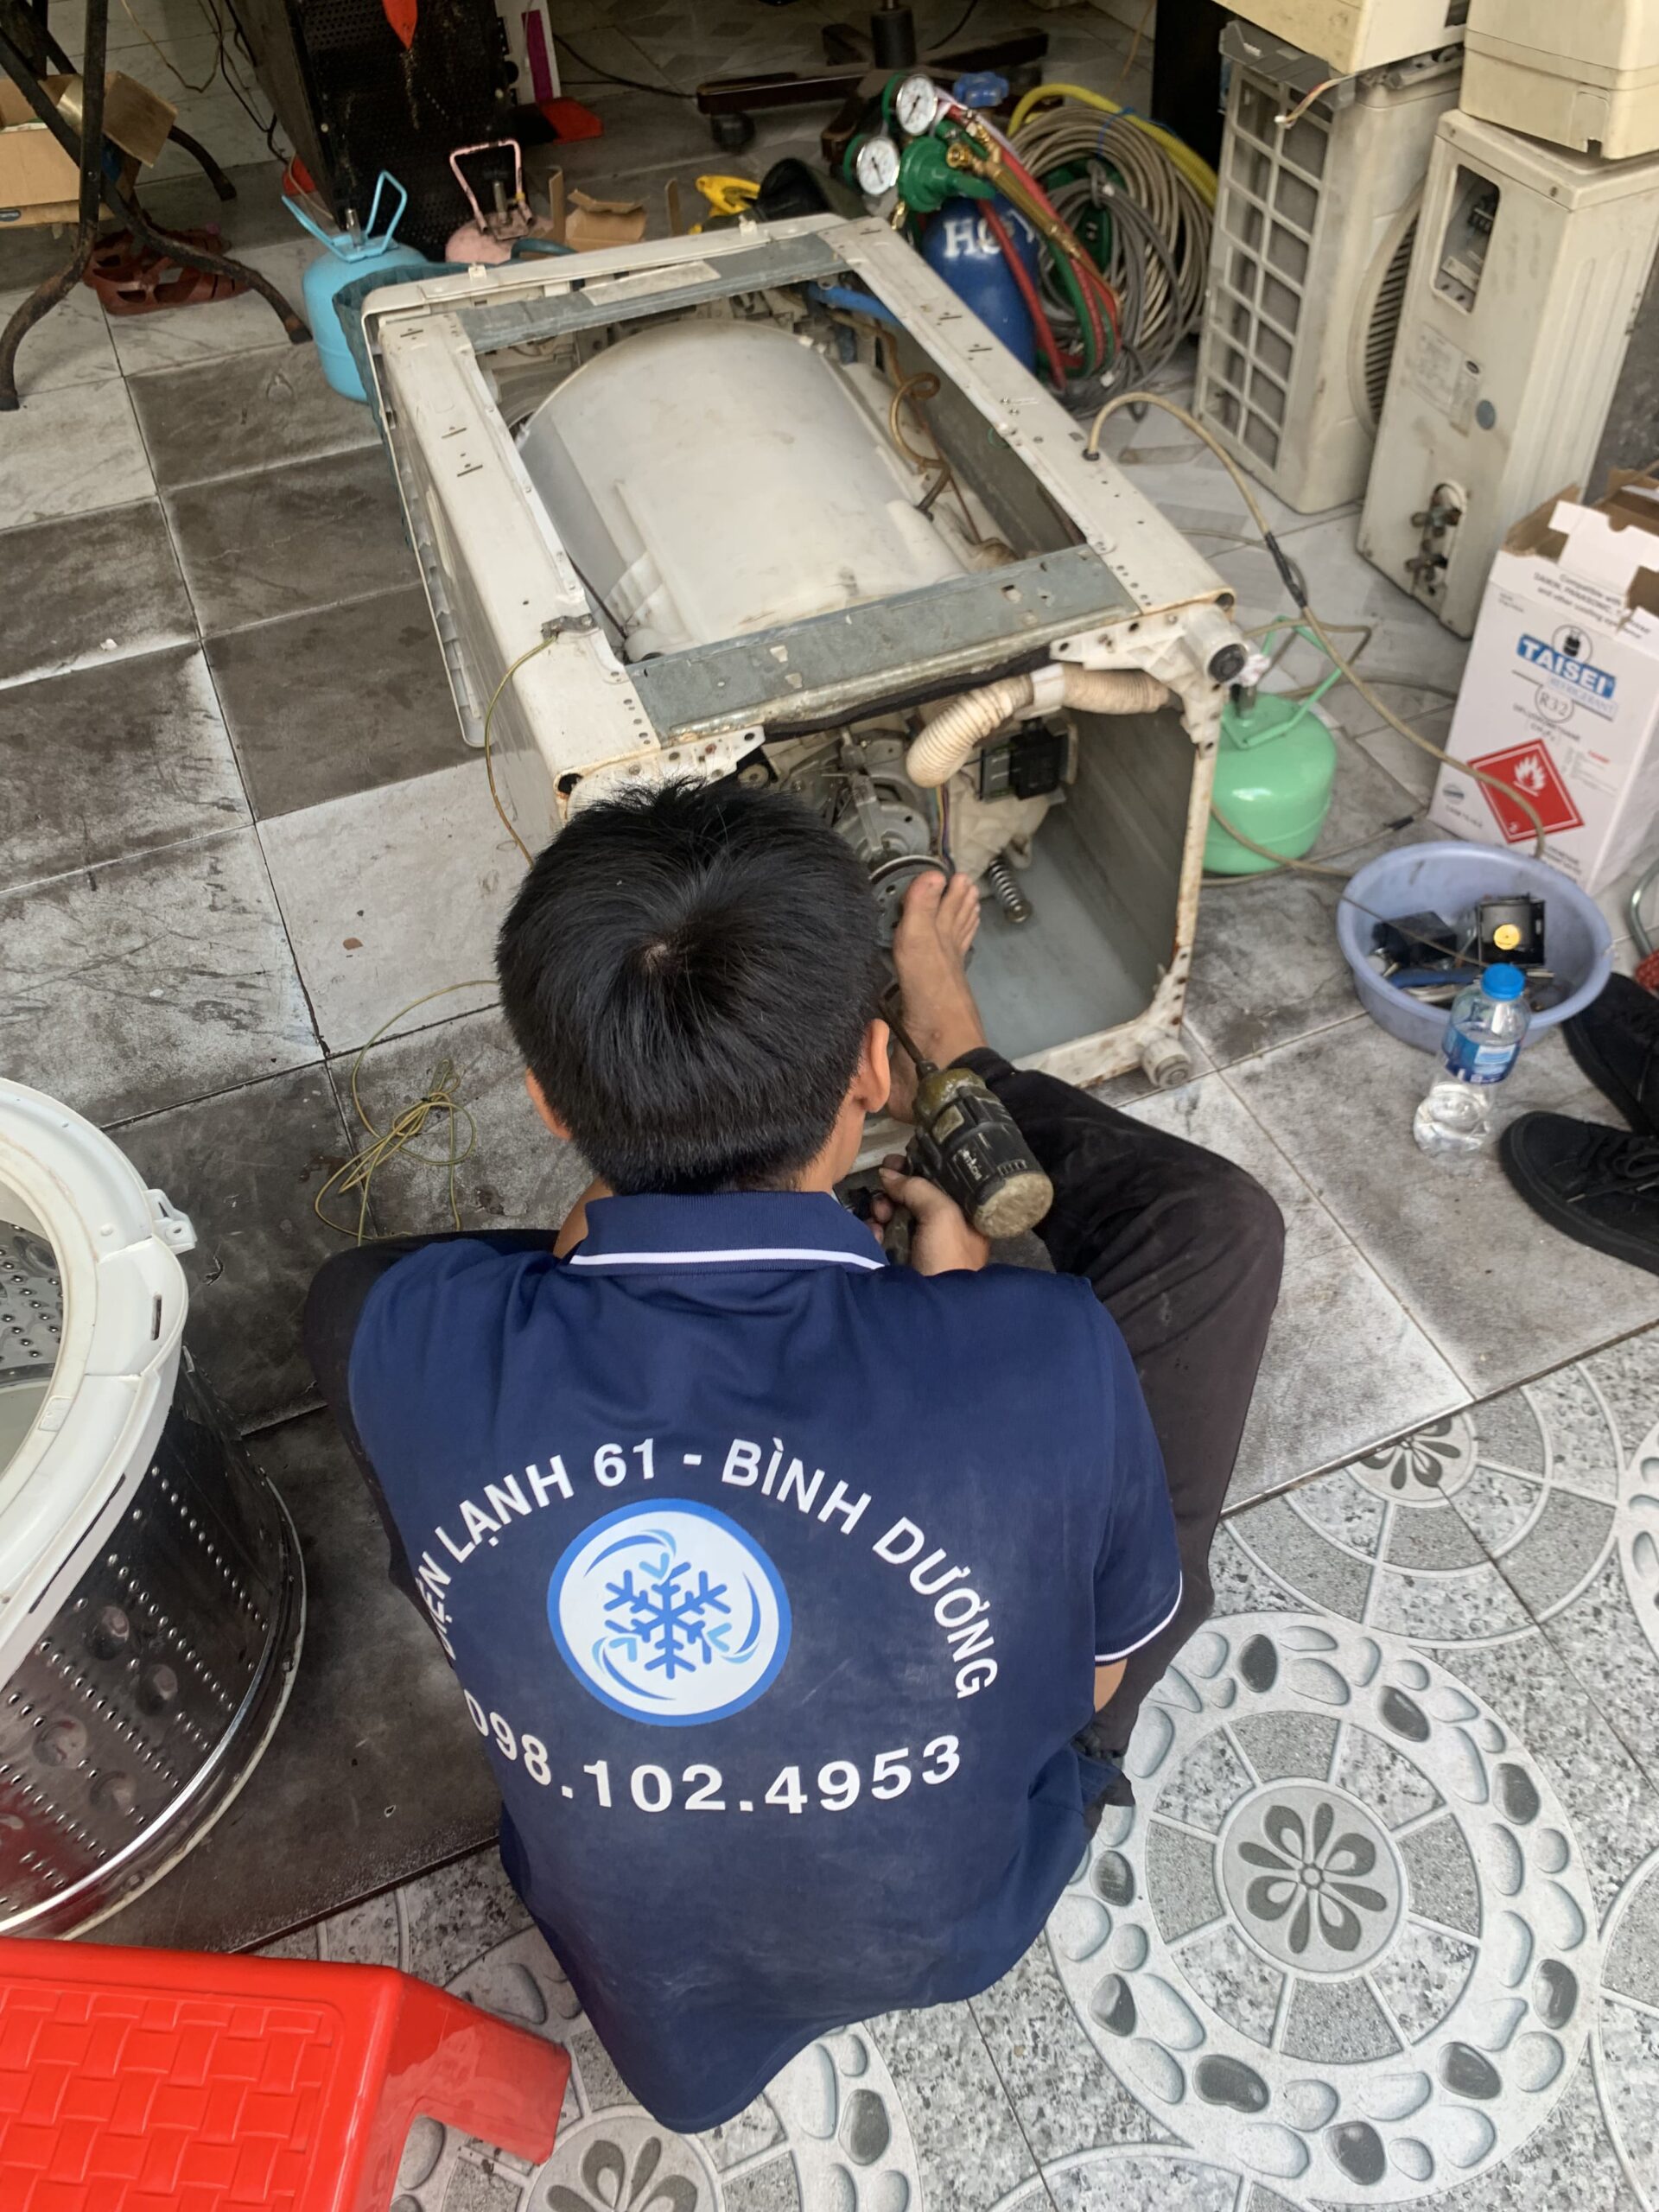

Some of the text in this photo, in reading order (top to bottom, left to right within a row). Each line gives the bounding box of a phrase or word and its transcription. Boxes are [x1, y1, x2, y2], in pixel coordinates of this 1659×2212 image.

[1521, 638, 1607, 696] TAISEI
[1540, 690, 1569, 717] R32
[435, 1454, 575, 1563] LẠNH
[594, 1438, 655, 1487] 61
[683, 1453, 702, 1466] -
[721, 1437, 872, 1535] BÌNH
[872, 1516, 998, 1700] DƯƠNG
[463, 1688, 960, 1815] 098.102.4953
